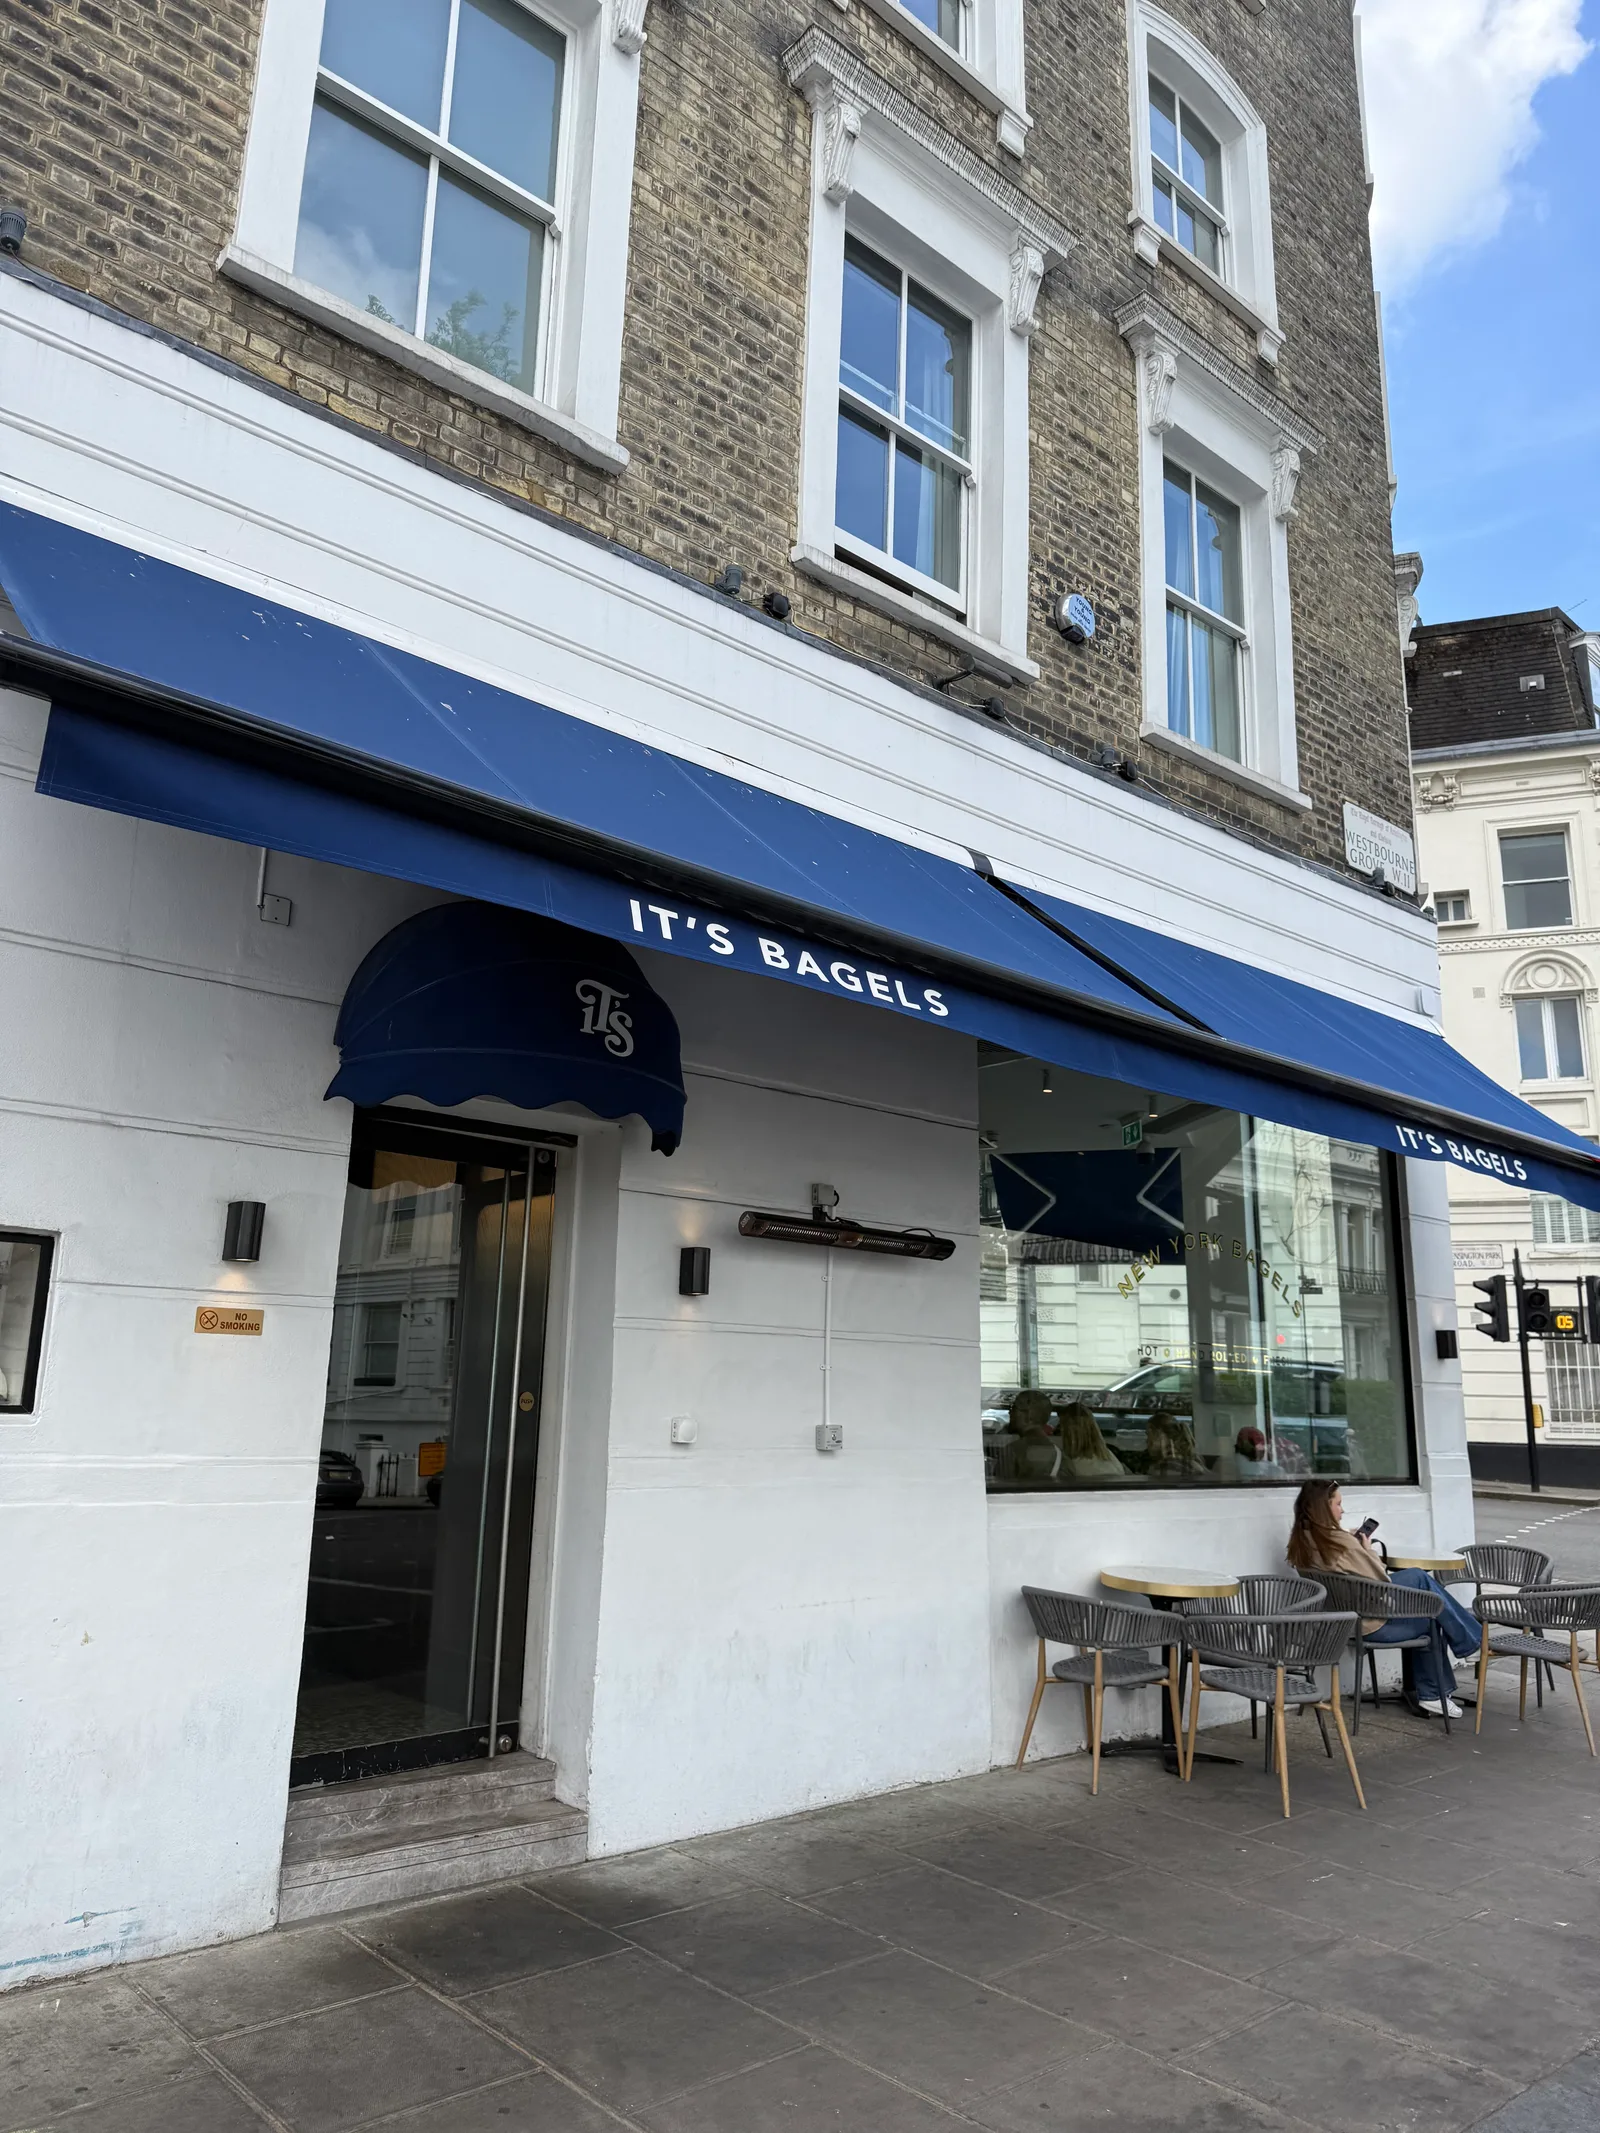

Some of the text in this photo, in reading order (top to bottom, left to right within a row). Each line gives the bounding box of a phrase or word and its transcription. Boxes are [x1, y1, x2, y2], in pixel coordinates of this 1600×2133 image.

[1345, 829, 1415, 875] WESTBOURNE
[629, 898, 949, 1017] IT'S BAGELS
[1395, 1124, 1527, 1181] IT'S BAGELS
[1117, 1231, 1303, 1318] NEW YORK BAGELS
[219, 1321, 260, 1331] SMOKING
[235, 1312, 248, 1321] NO
[1556, 1315, 1574, 1329] 05
[1137, 1345, 1158, 1357] HOT
